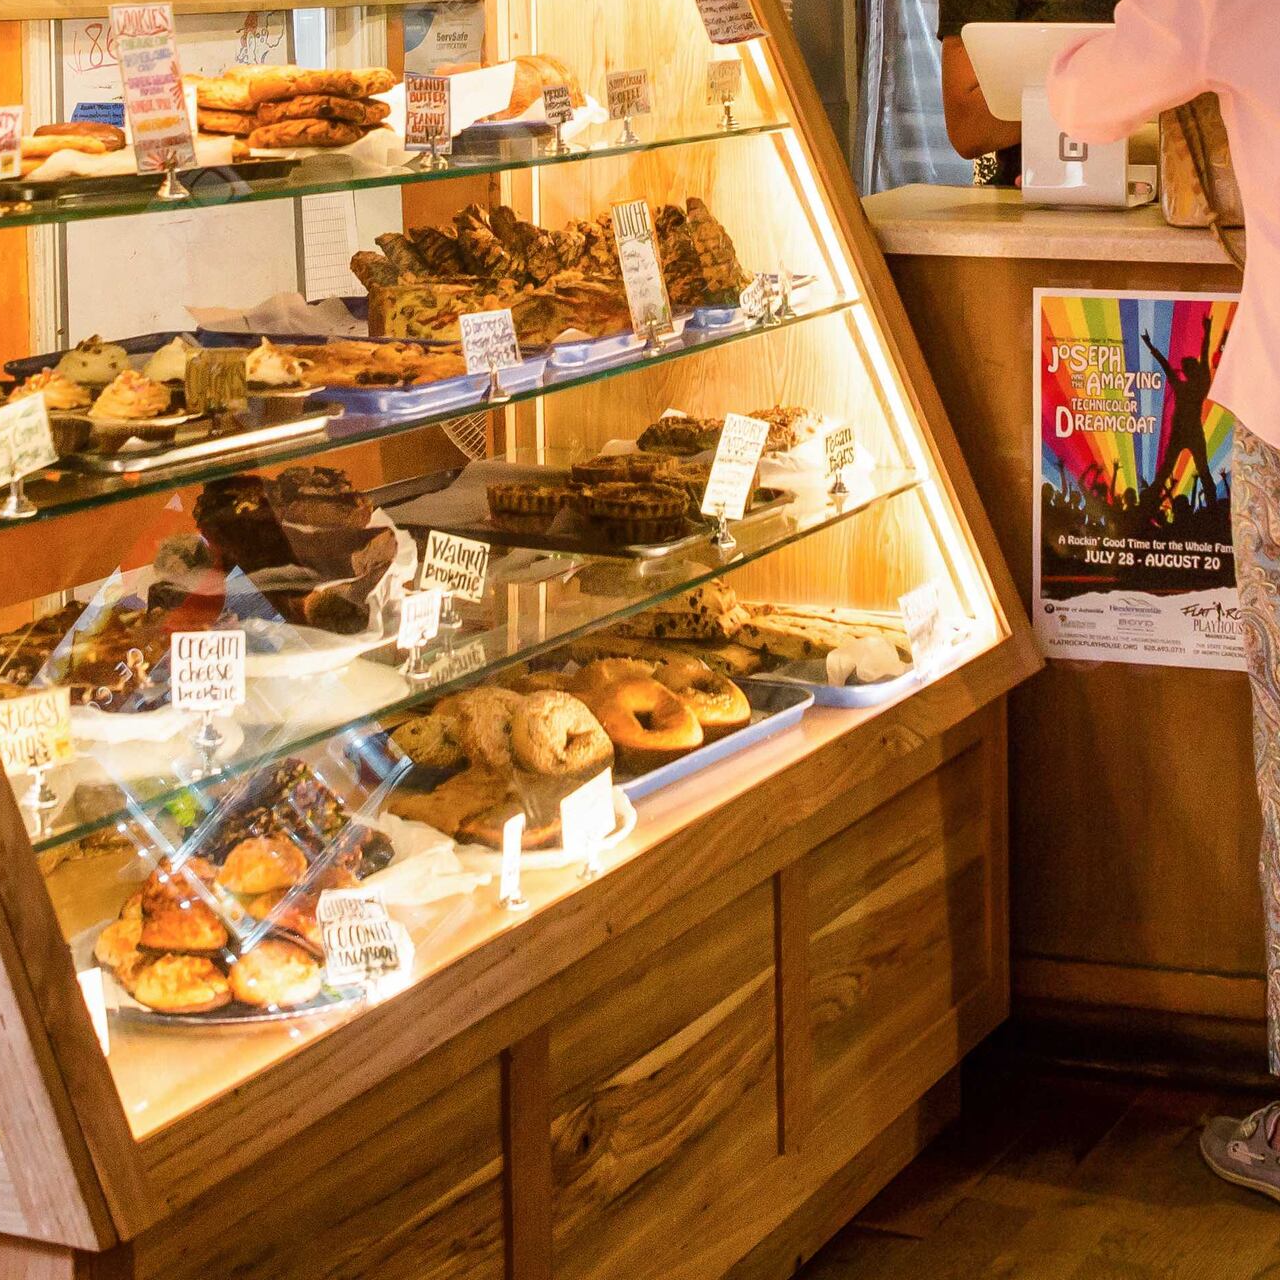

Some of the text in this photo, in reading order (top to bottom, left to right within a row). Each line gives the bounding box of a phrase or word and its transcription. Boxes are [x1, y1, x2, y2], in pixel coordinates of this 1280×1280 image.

[436, 31, 469, 42] ServSafe
[407, 79, 446, 92] PEANUT
[1047, 345, 1121, 373] JOSEPH
[1086, 372, 1162, 398] AMAZING
[1071, 398, 1138, 413] TECHNICOLOR
[1055, 405, 1157, 438] DREAMCOAT
[431, 534, 488, 570] Walnut
[1084, 550, 1221, 570] JULY 28 AUGUST 20
[178, 634, 240, 661] cream
[178, 661, 235, 683] cheese
